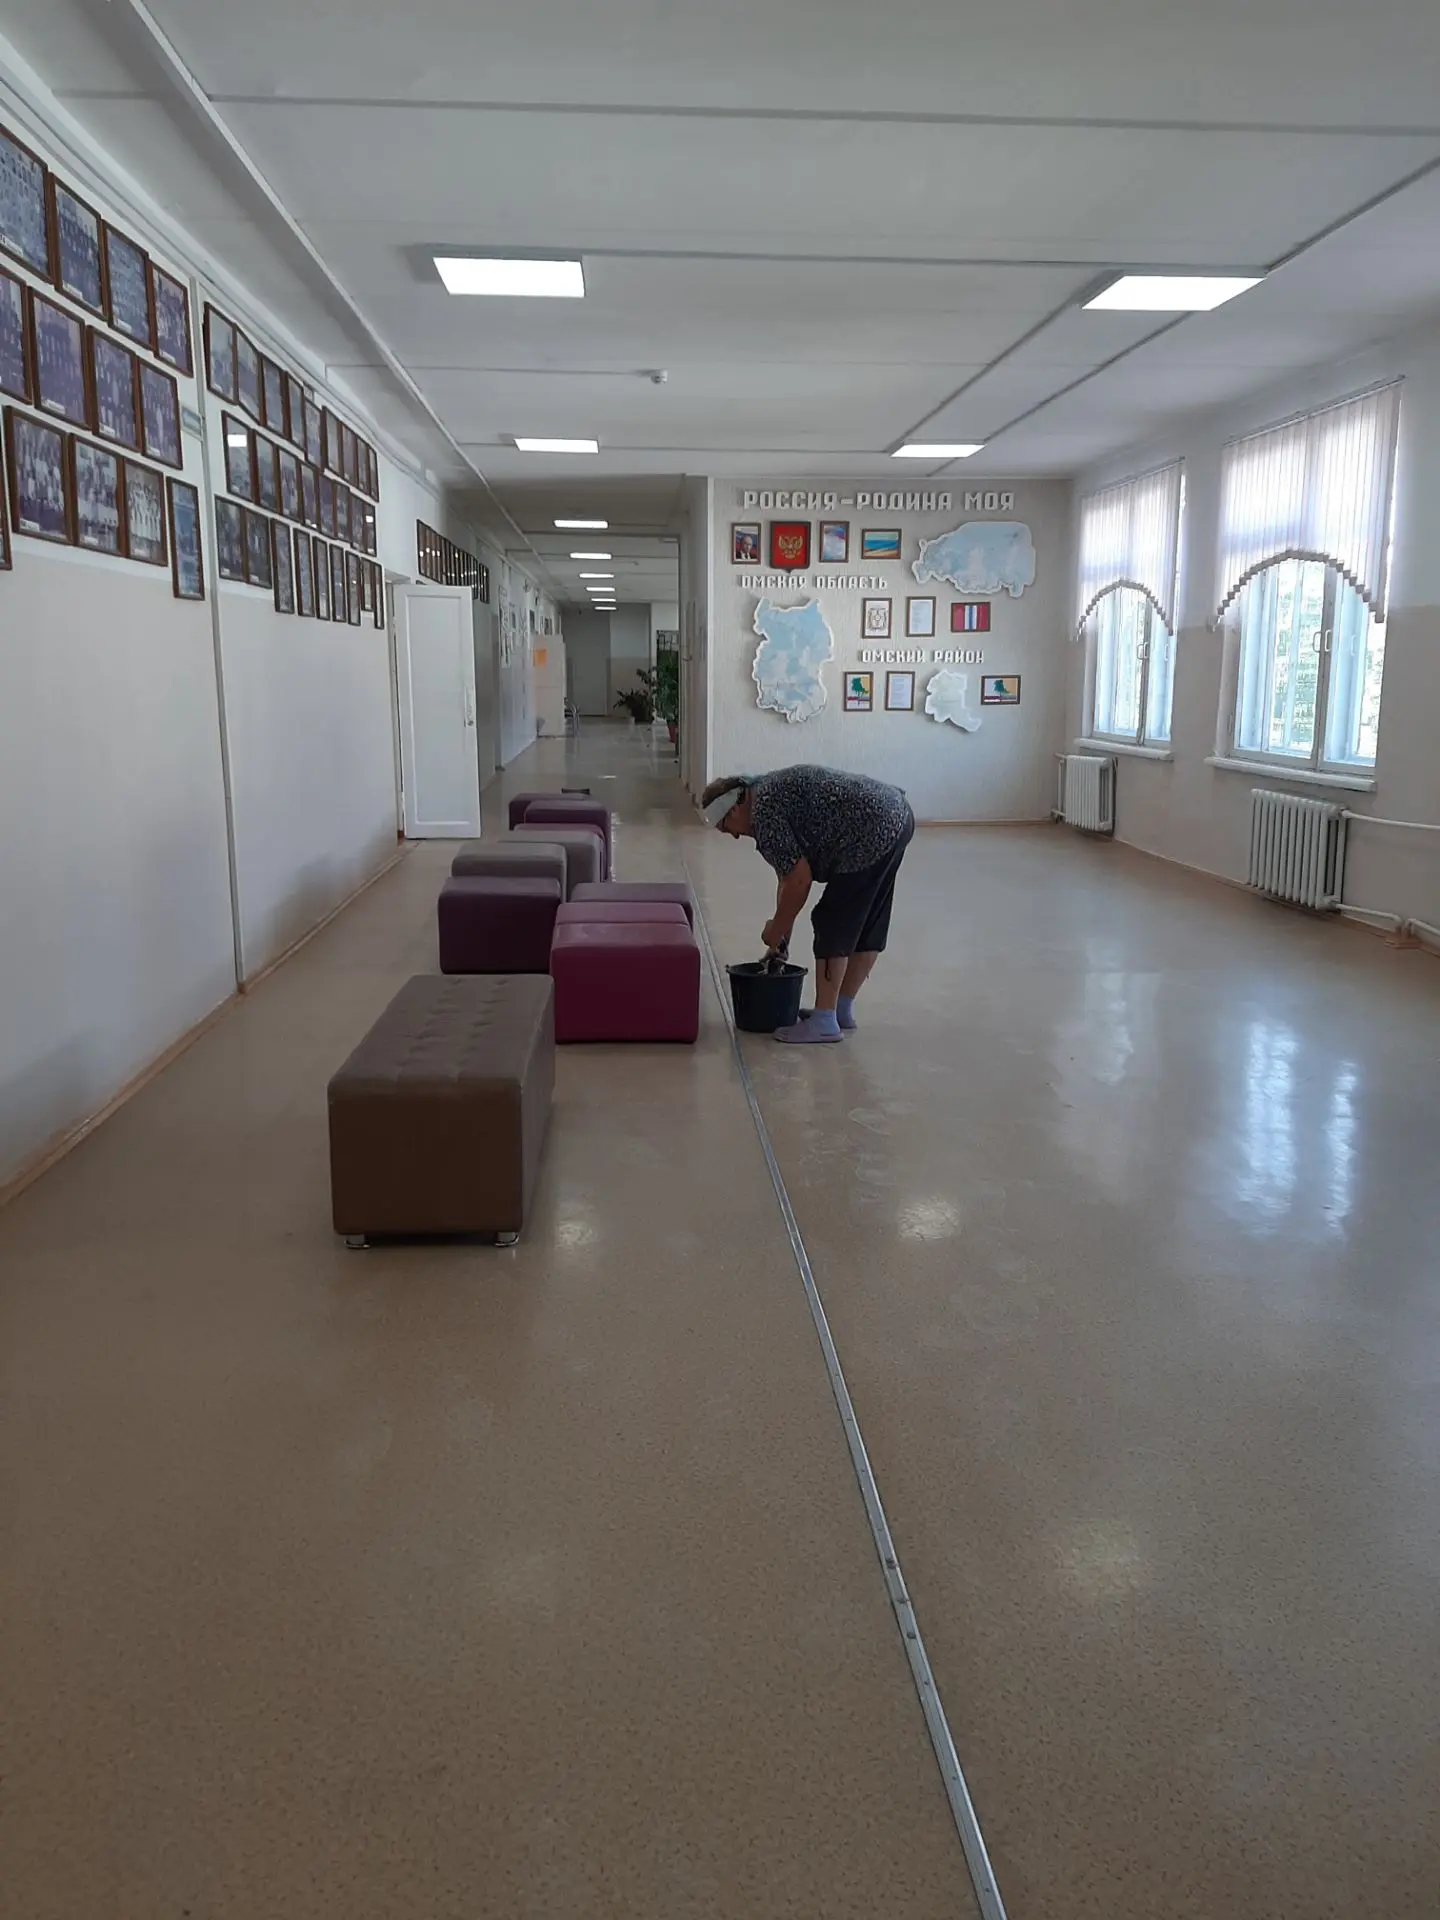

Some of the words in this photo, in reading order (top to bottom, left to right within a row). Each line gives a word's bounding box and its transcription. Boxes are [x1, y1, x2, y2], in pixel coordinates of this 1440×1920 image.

[964, 491, 1015, 511] МОЯ
[741, 575, 807, 589] ОМСКАЯ
[816, 575, 888, 589] ОБЛАСТЬ
[862, 646, 926, 663] ОМСКИЙ
[934, 646, 984, 663] РАЙОН
